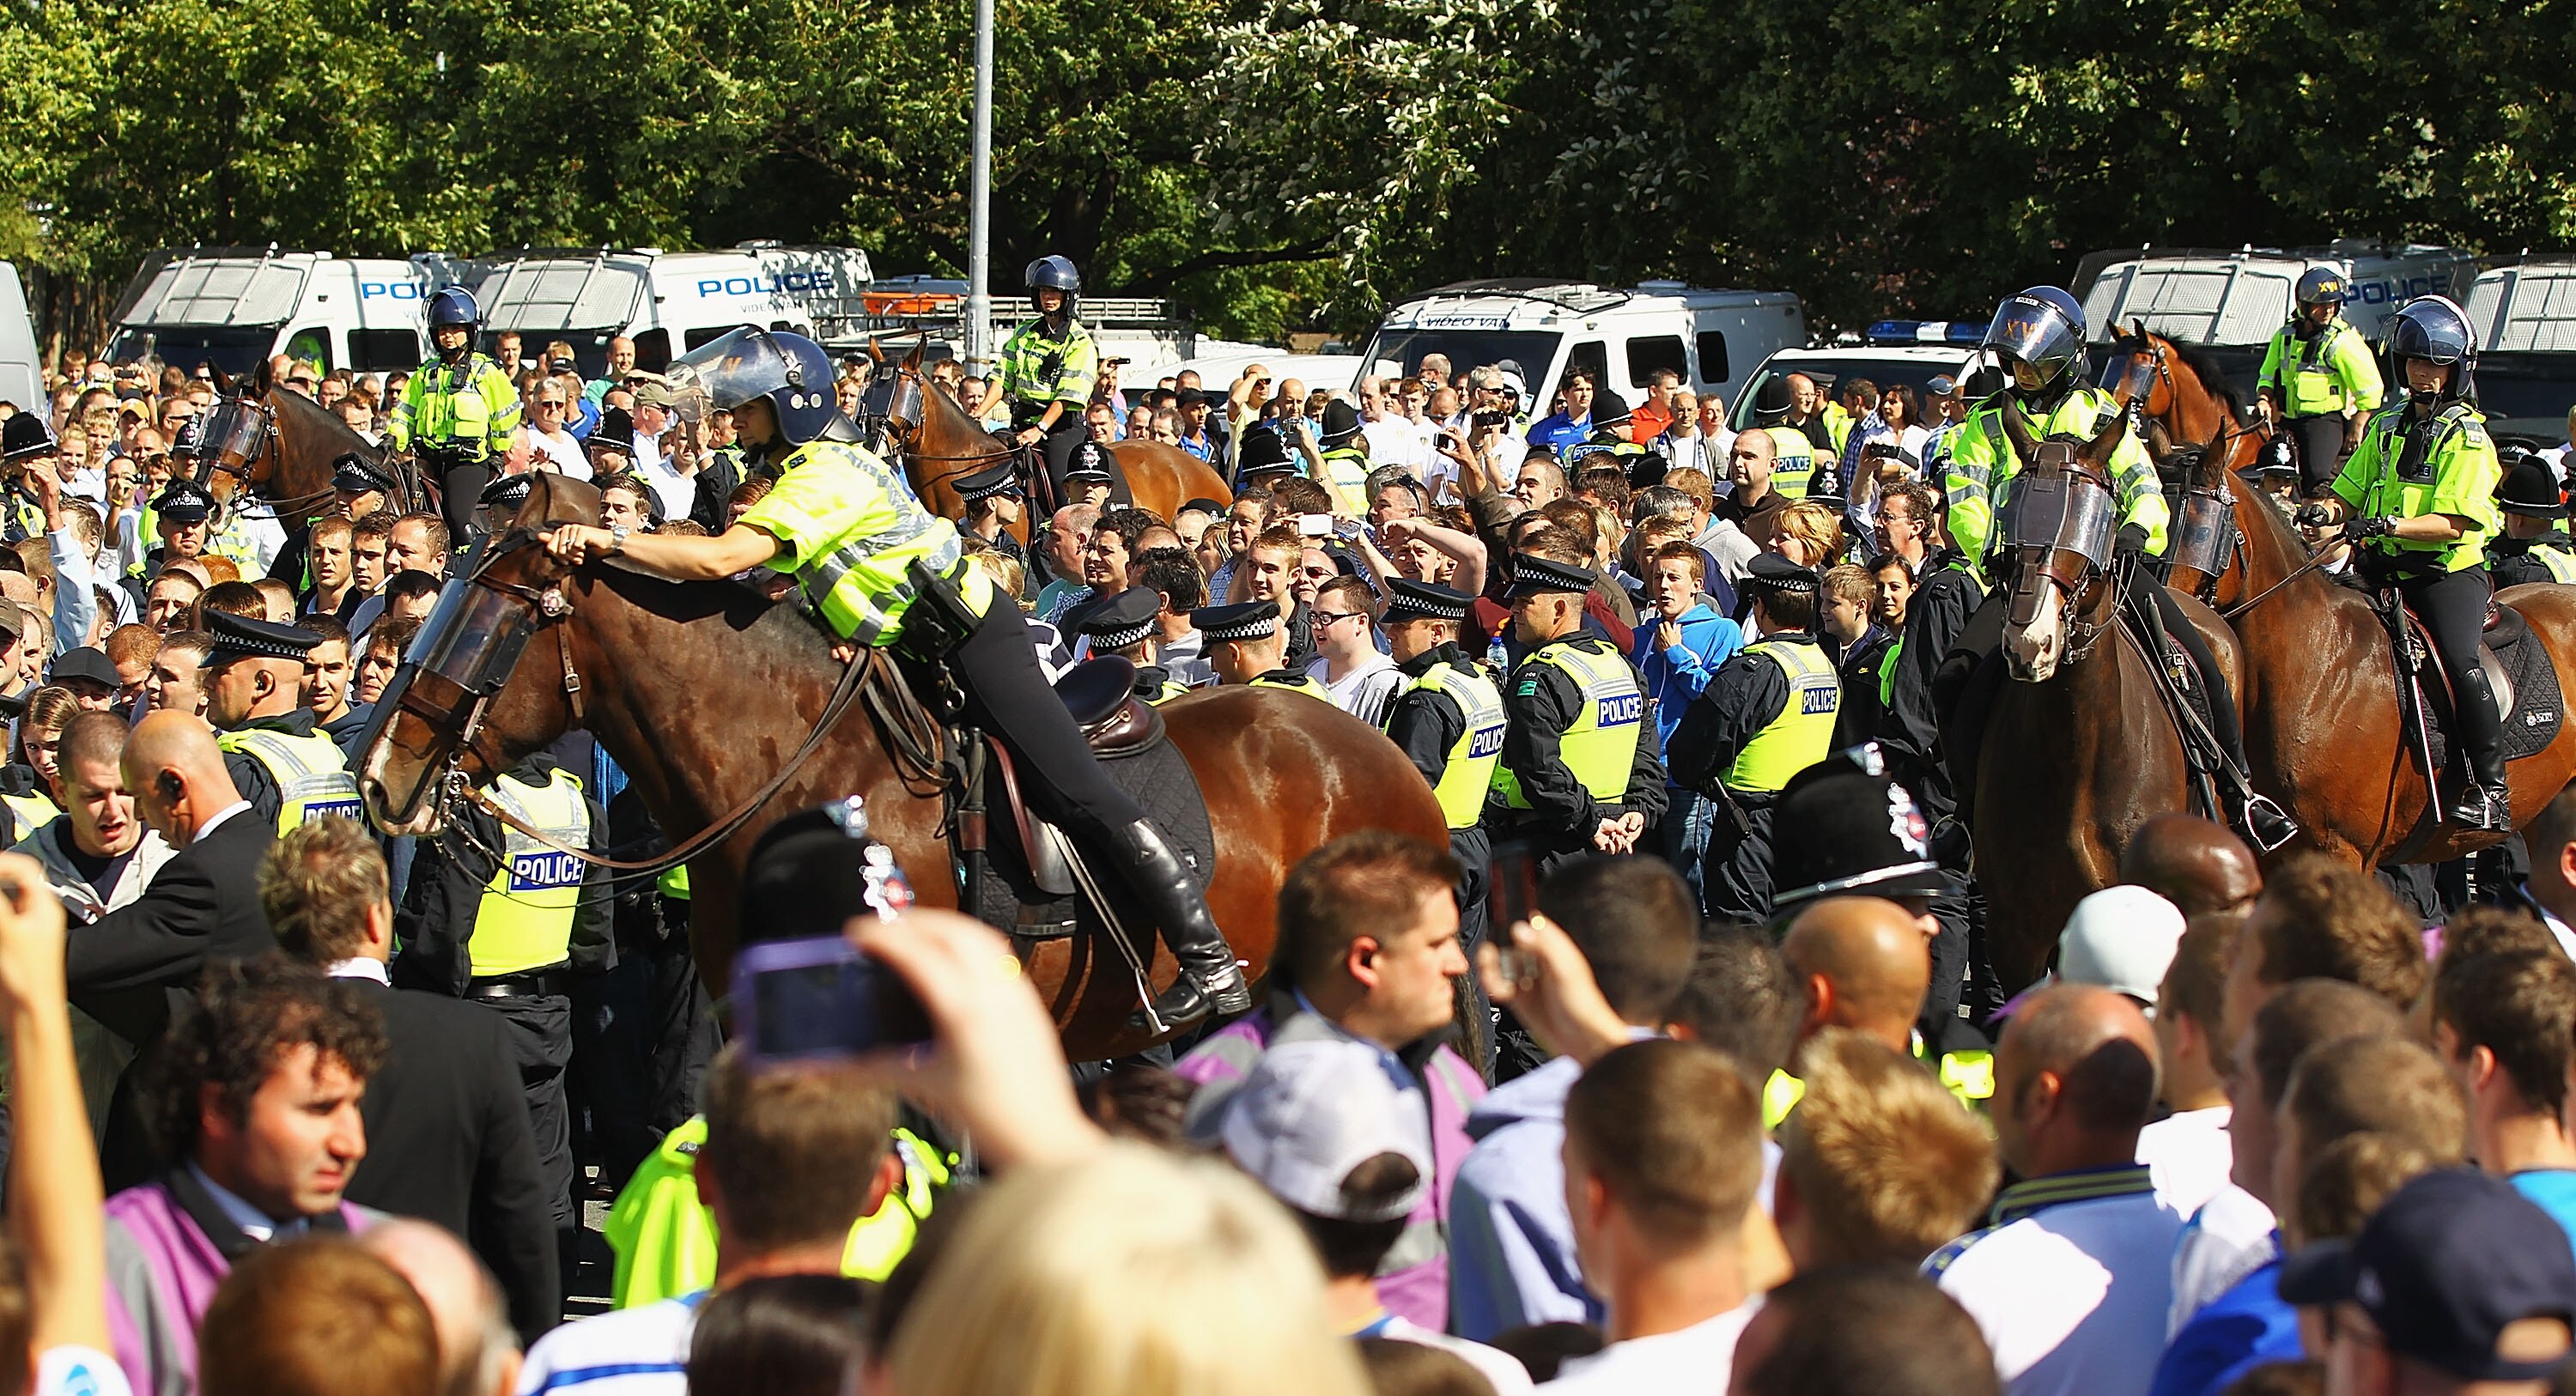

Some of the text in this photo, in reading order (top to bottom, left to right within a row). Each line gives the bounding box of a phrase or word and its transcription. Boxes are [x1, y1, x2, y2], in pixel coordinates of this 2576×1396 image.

[361, 282, 448, 299] POL
[697, 271, 834, 298] POLICE
[2342, 275, 2448, 307] POLICE
[1427, 317, 1475, 327] VIDEO
[1777, 457, 1810, 472] POLICE
[1600, 696, 1642, 724] POLICE
[1803, 689, 1837, 713] POLICE
[1471, 727, 1505, 755] POLICE
[305, 805, 360, 825] POCE
[513, 855, 582, 886] POLICE
